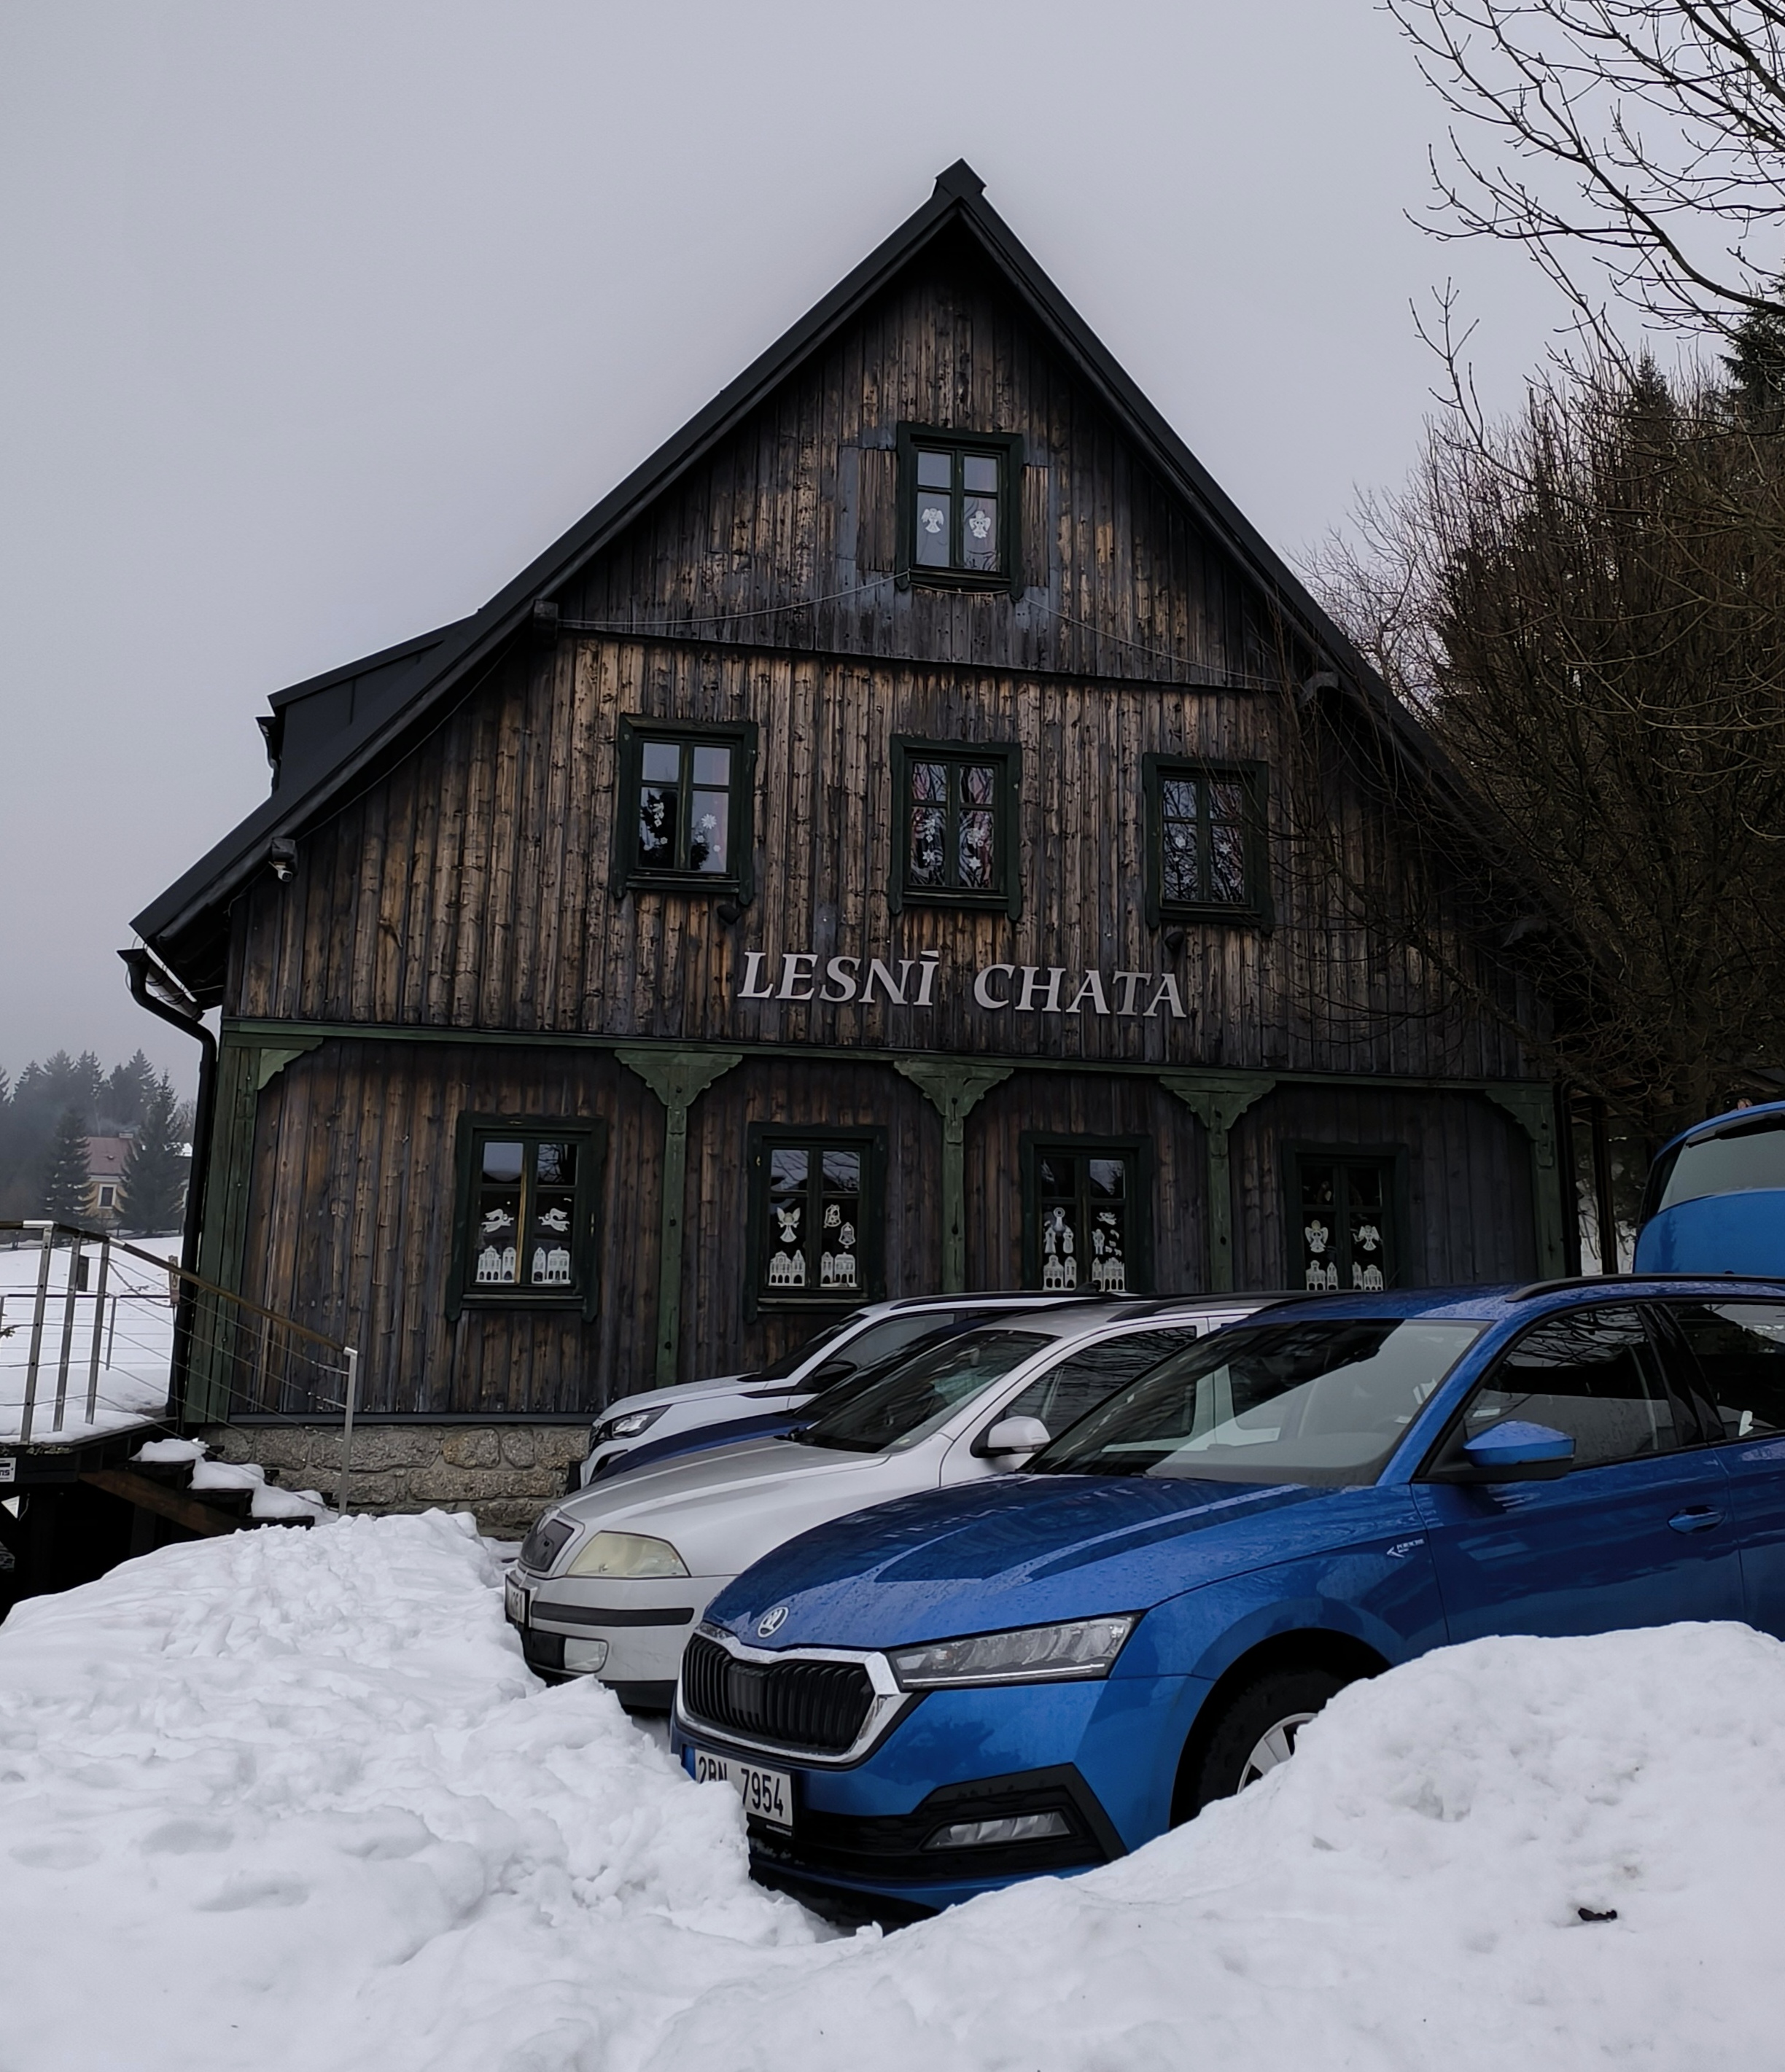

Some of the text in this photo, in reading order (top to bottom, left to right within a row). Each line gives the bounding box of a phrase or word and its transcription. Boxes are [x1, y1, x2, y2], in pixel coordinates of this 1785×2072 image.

[737, 950, 1186, 1018] LESNÍ CHATA
[741, 1767, 783, 1818] 7954
